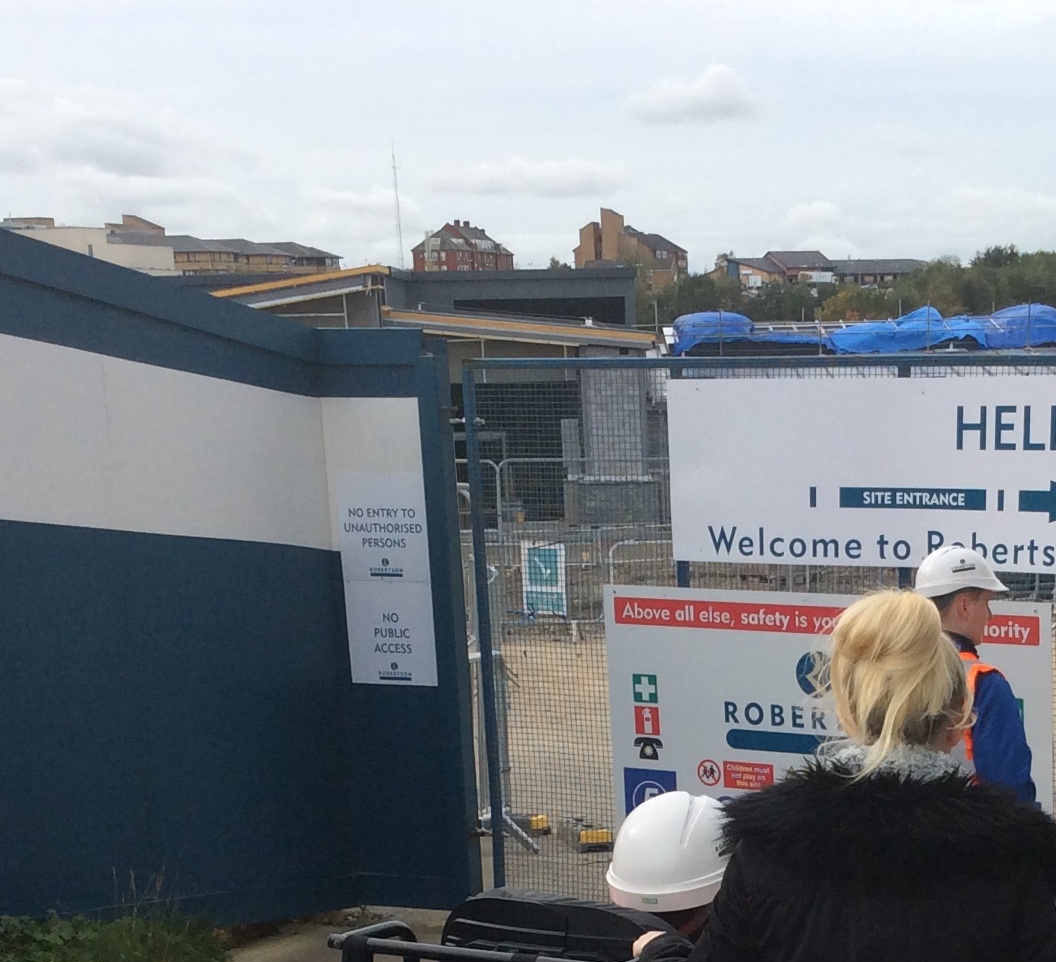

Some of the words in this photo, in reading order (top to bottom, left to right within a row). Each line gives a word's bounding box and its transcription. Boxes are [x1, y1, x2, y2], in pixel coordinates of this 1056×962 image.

[862, 491, 893, 505] SITE
[895, 492, 966, 507] ENTRANCE
[348, 508, 364, 518] NO
[366, 508, 398, 518] ENTRY
[400, 508, 415, 518] TO
[343, 523, 423, 534] UNAUTHORISED
[362, 538, 407, 548] PERSONS
[708, 525, 862, 559] Welcome
[877, 533, 911, 561] to
[382, 612, 399, 623] NO
[622, 602, 670, 620] Above
[675, 605, 694, 621] all
[700, 606, 735, 627] else,
[741, 608, 790, 630] safety
[795, 611, 808, 628] is
[374, 628, 410, 639] PUBLIC
[374, 643, 412, 654] ACCESS
[724, 701, 842, 731] ROBER
